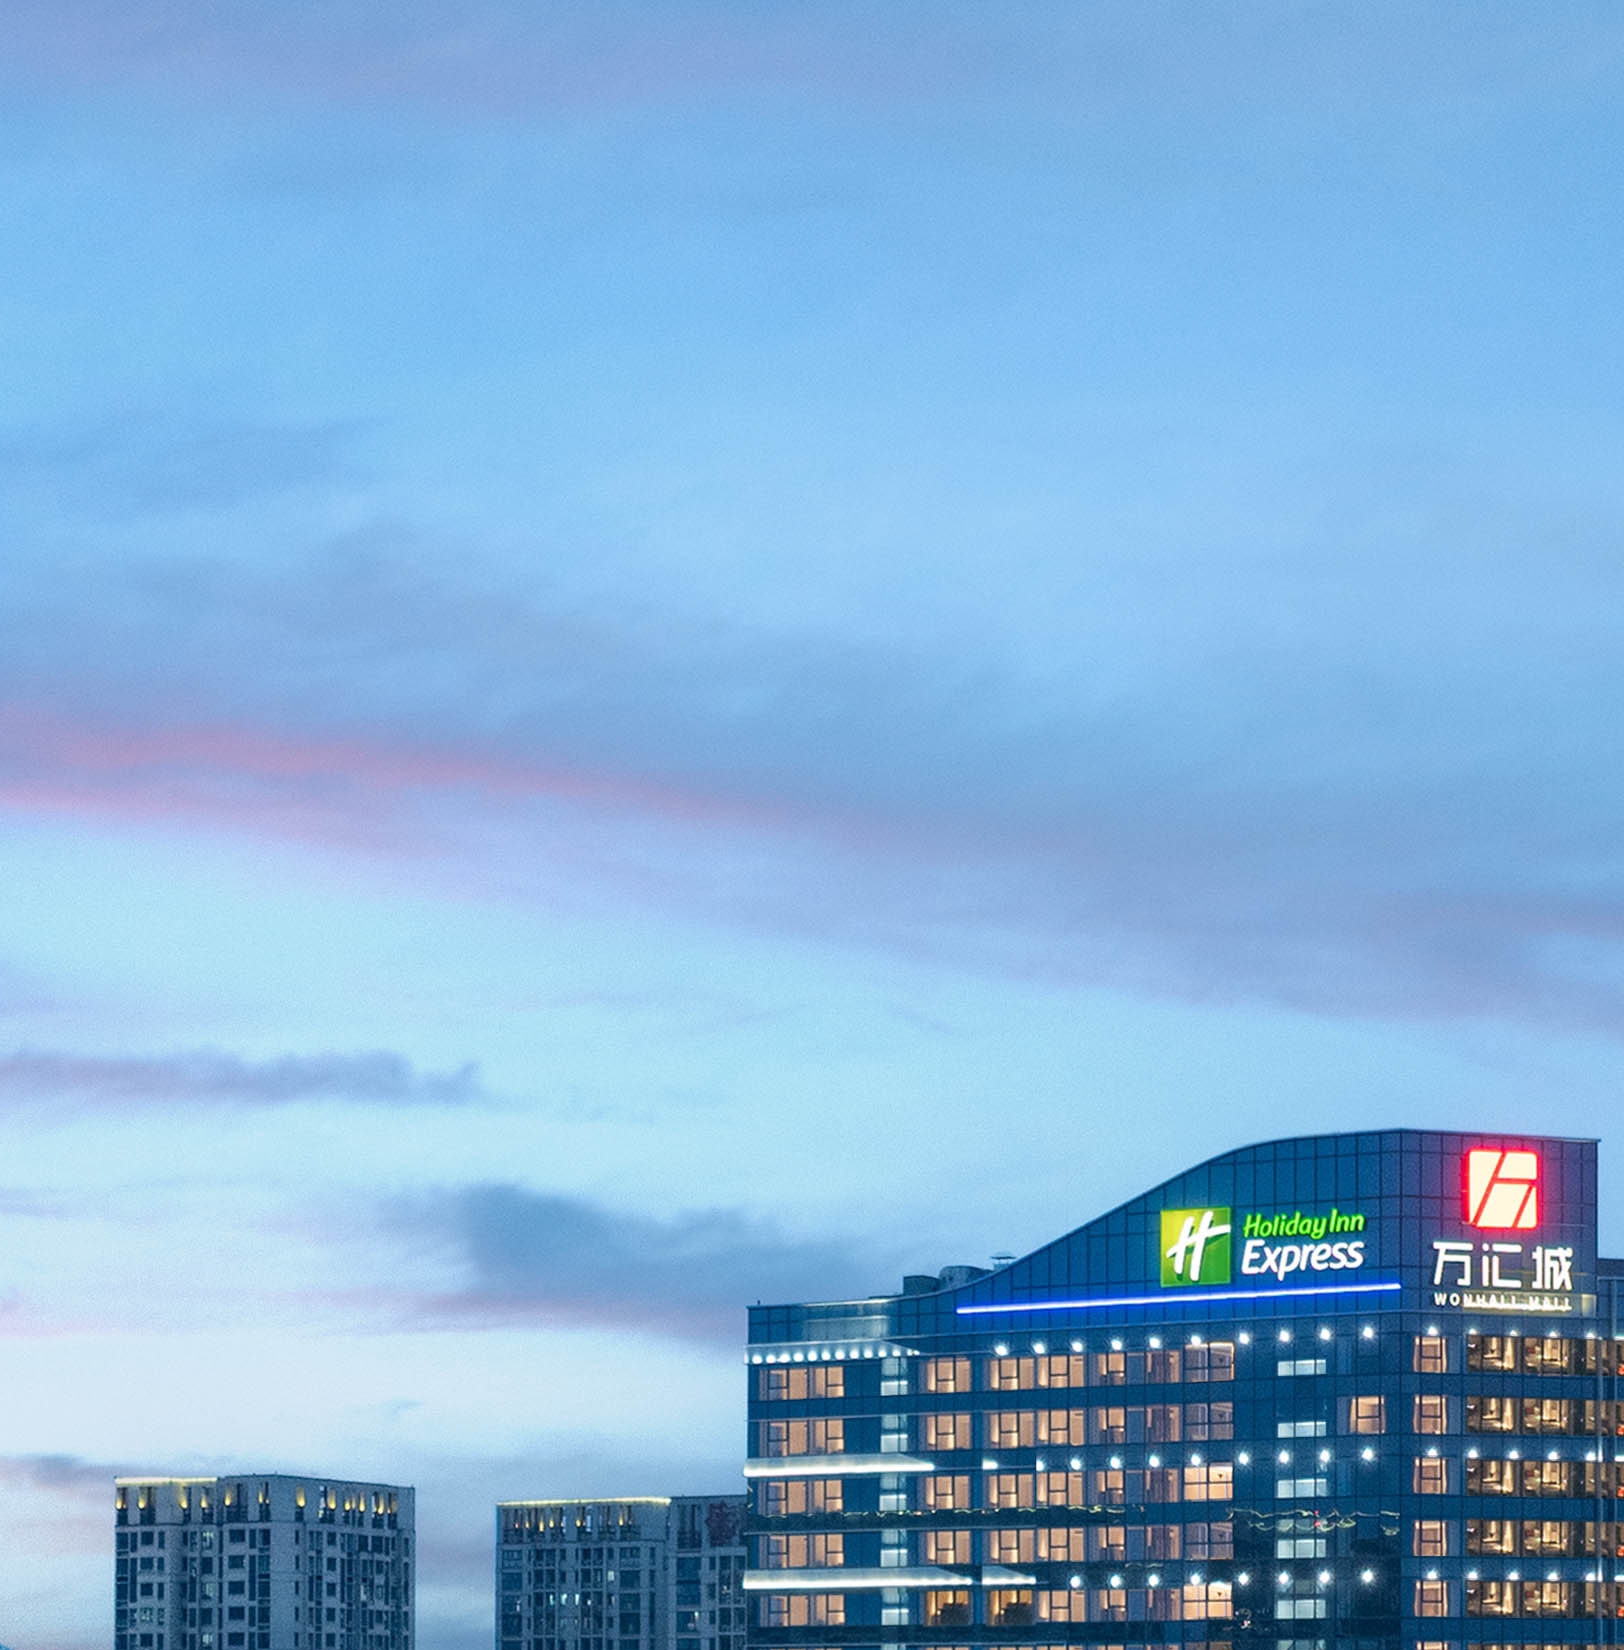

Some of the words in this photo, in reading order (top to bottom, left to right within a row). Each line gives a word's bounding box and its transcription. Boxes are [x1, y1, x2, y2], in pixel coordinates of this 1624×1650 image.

[1243, 1211, 1326, 1239] Holiday
[1329, 1208, 1365, 1233] Inn
[1241, 1239, 1365, 1282] Express
[1433, 1241, 1573, 1290] 万汇城
[1434, 1292, 1527, 1310] WONHALL
[1528, 1296, 1573, 1312] MALL
